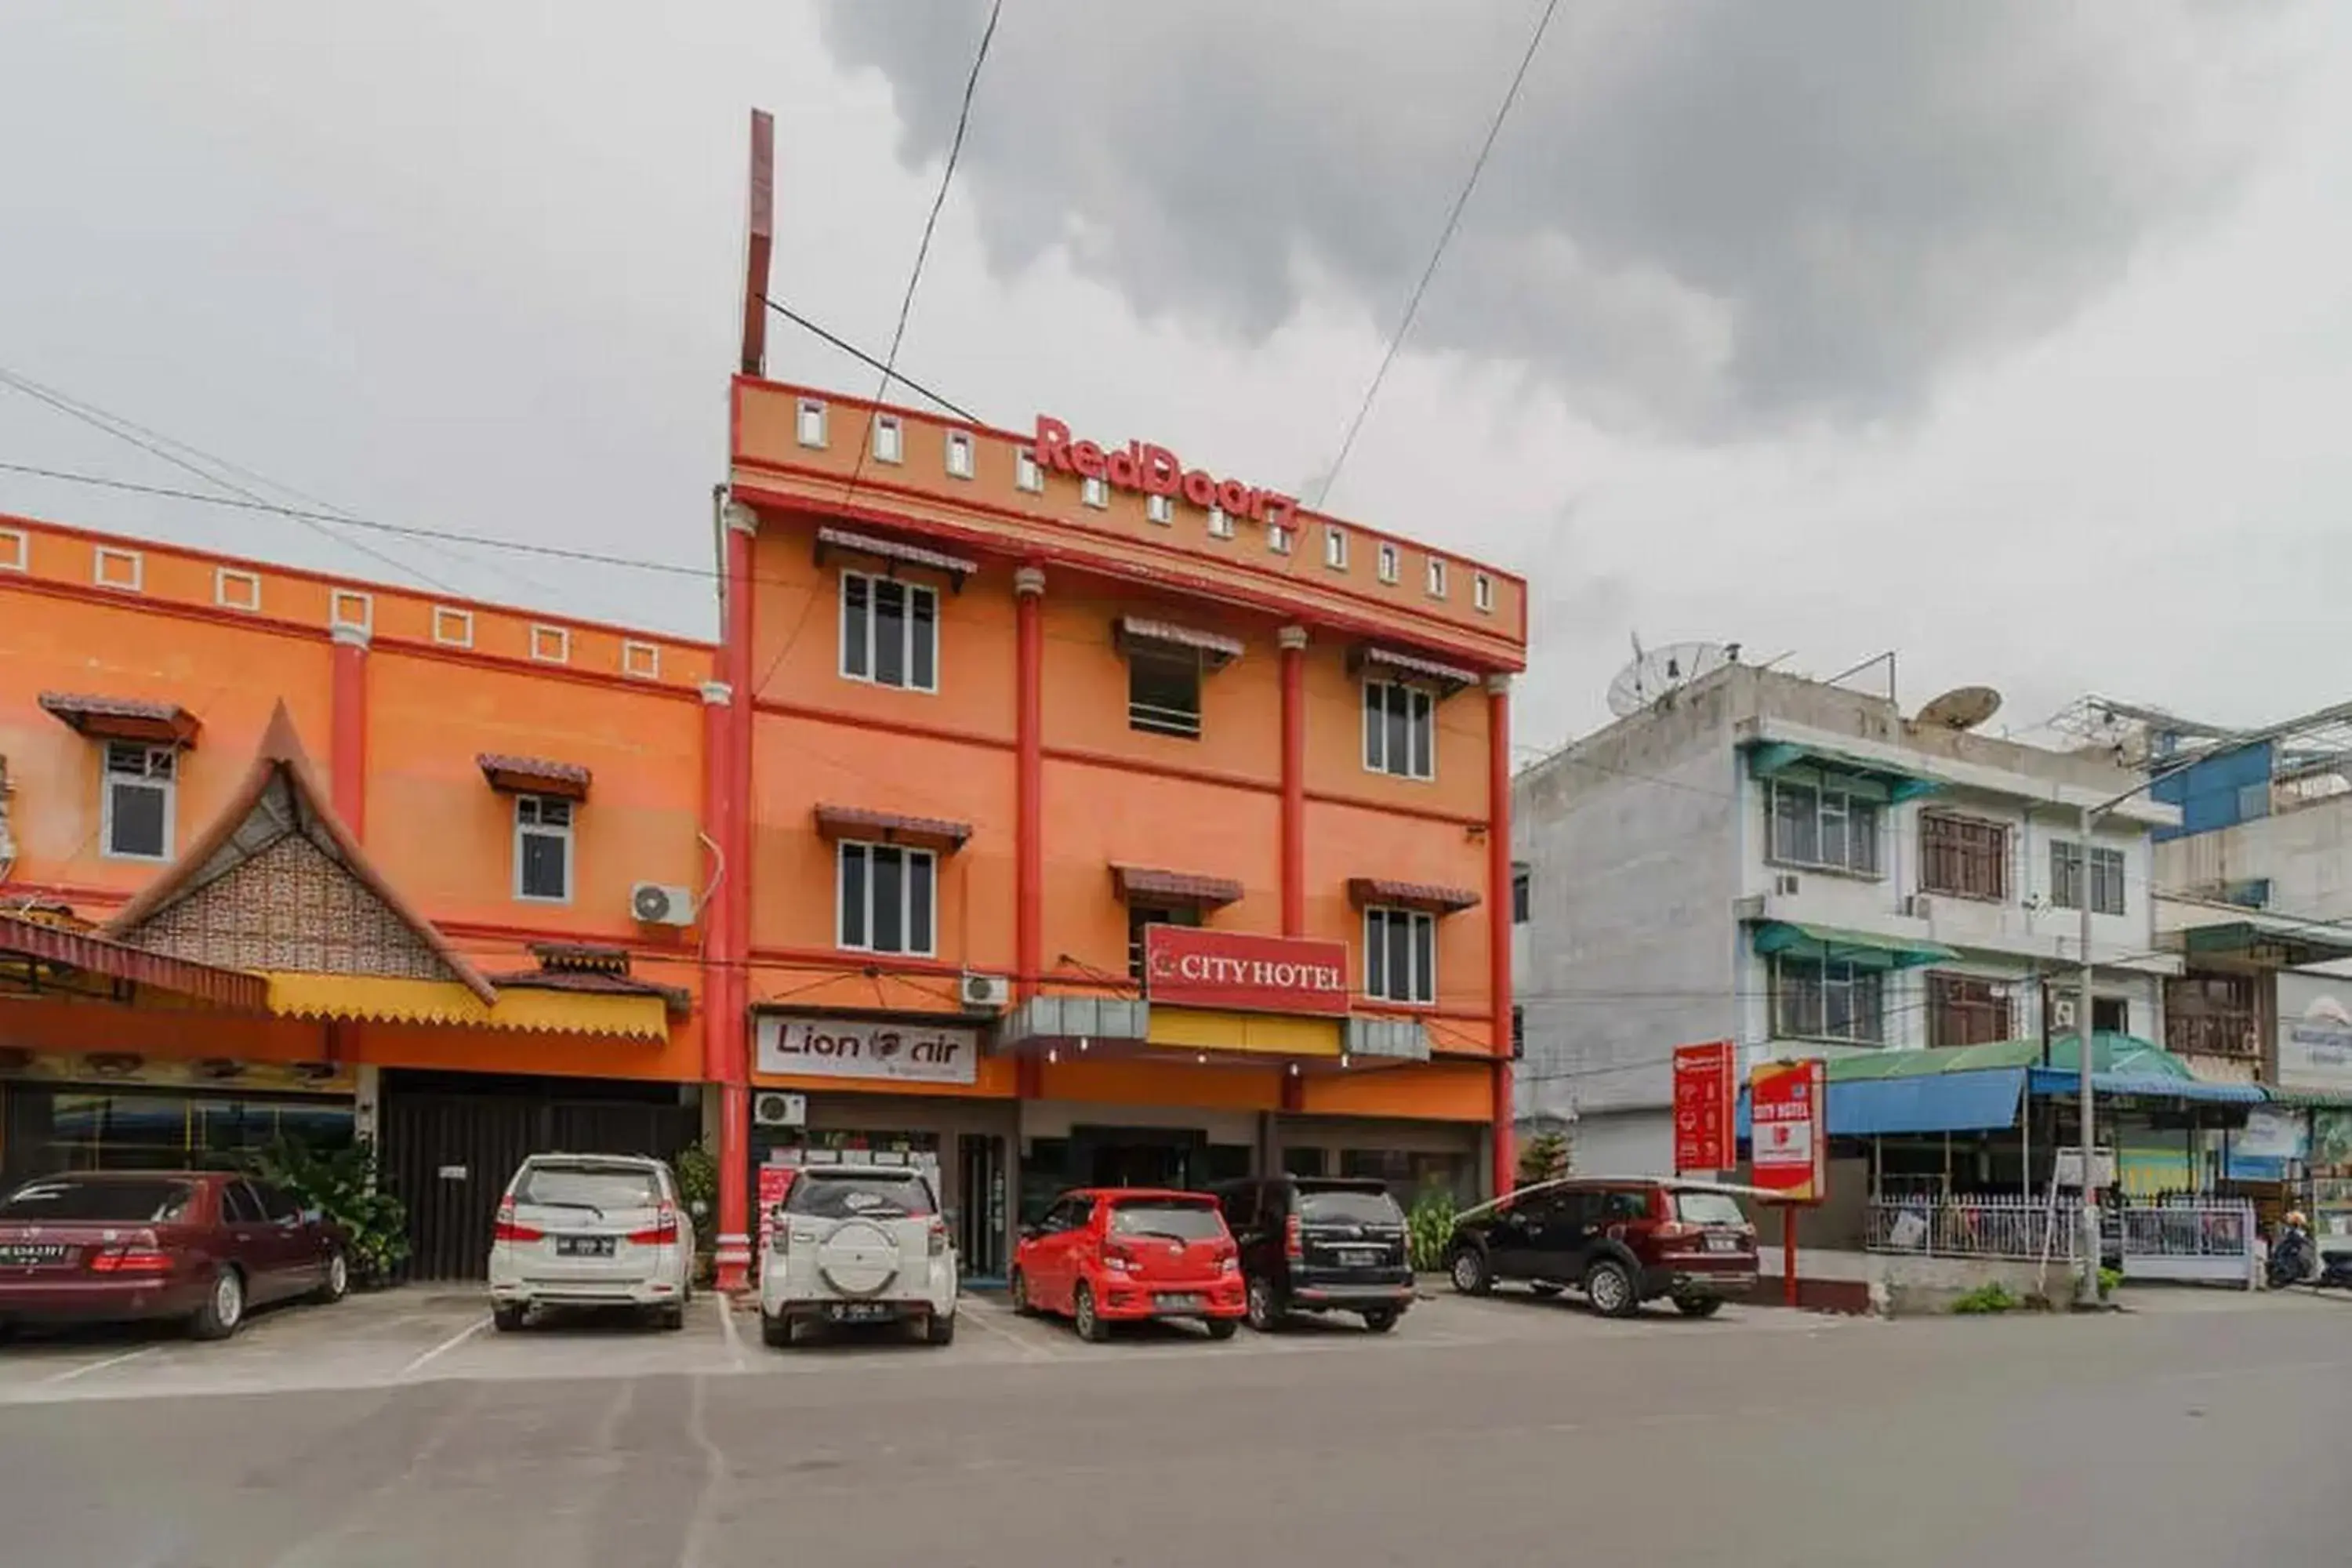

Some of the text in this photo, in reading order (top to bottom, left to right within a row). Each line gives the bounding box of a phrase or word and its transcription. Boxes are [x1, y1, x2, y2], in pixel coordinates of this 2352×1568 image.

[1035, 413, 1300, 531] RedDoorz
[1180, 953, 1345, 991] CITY HOTEL
[776, 1023, 960, 1065] Lion air
